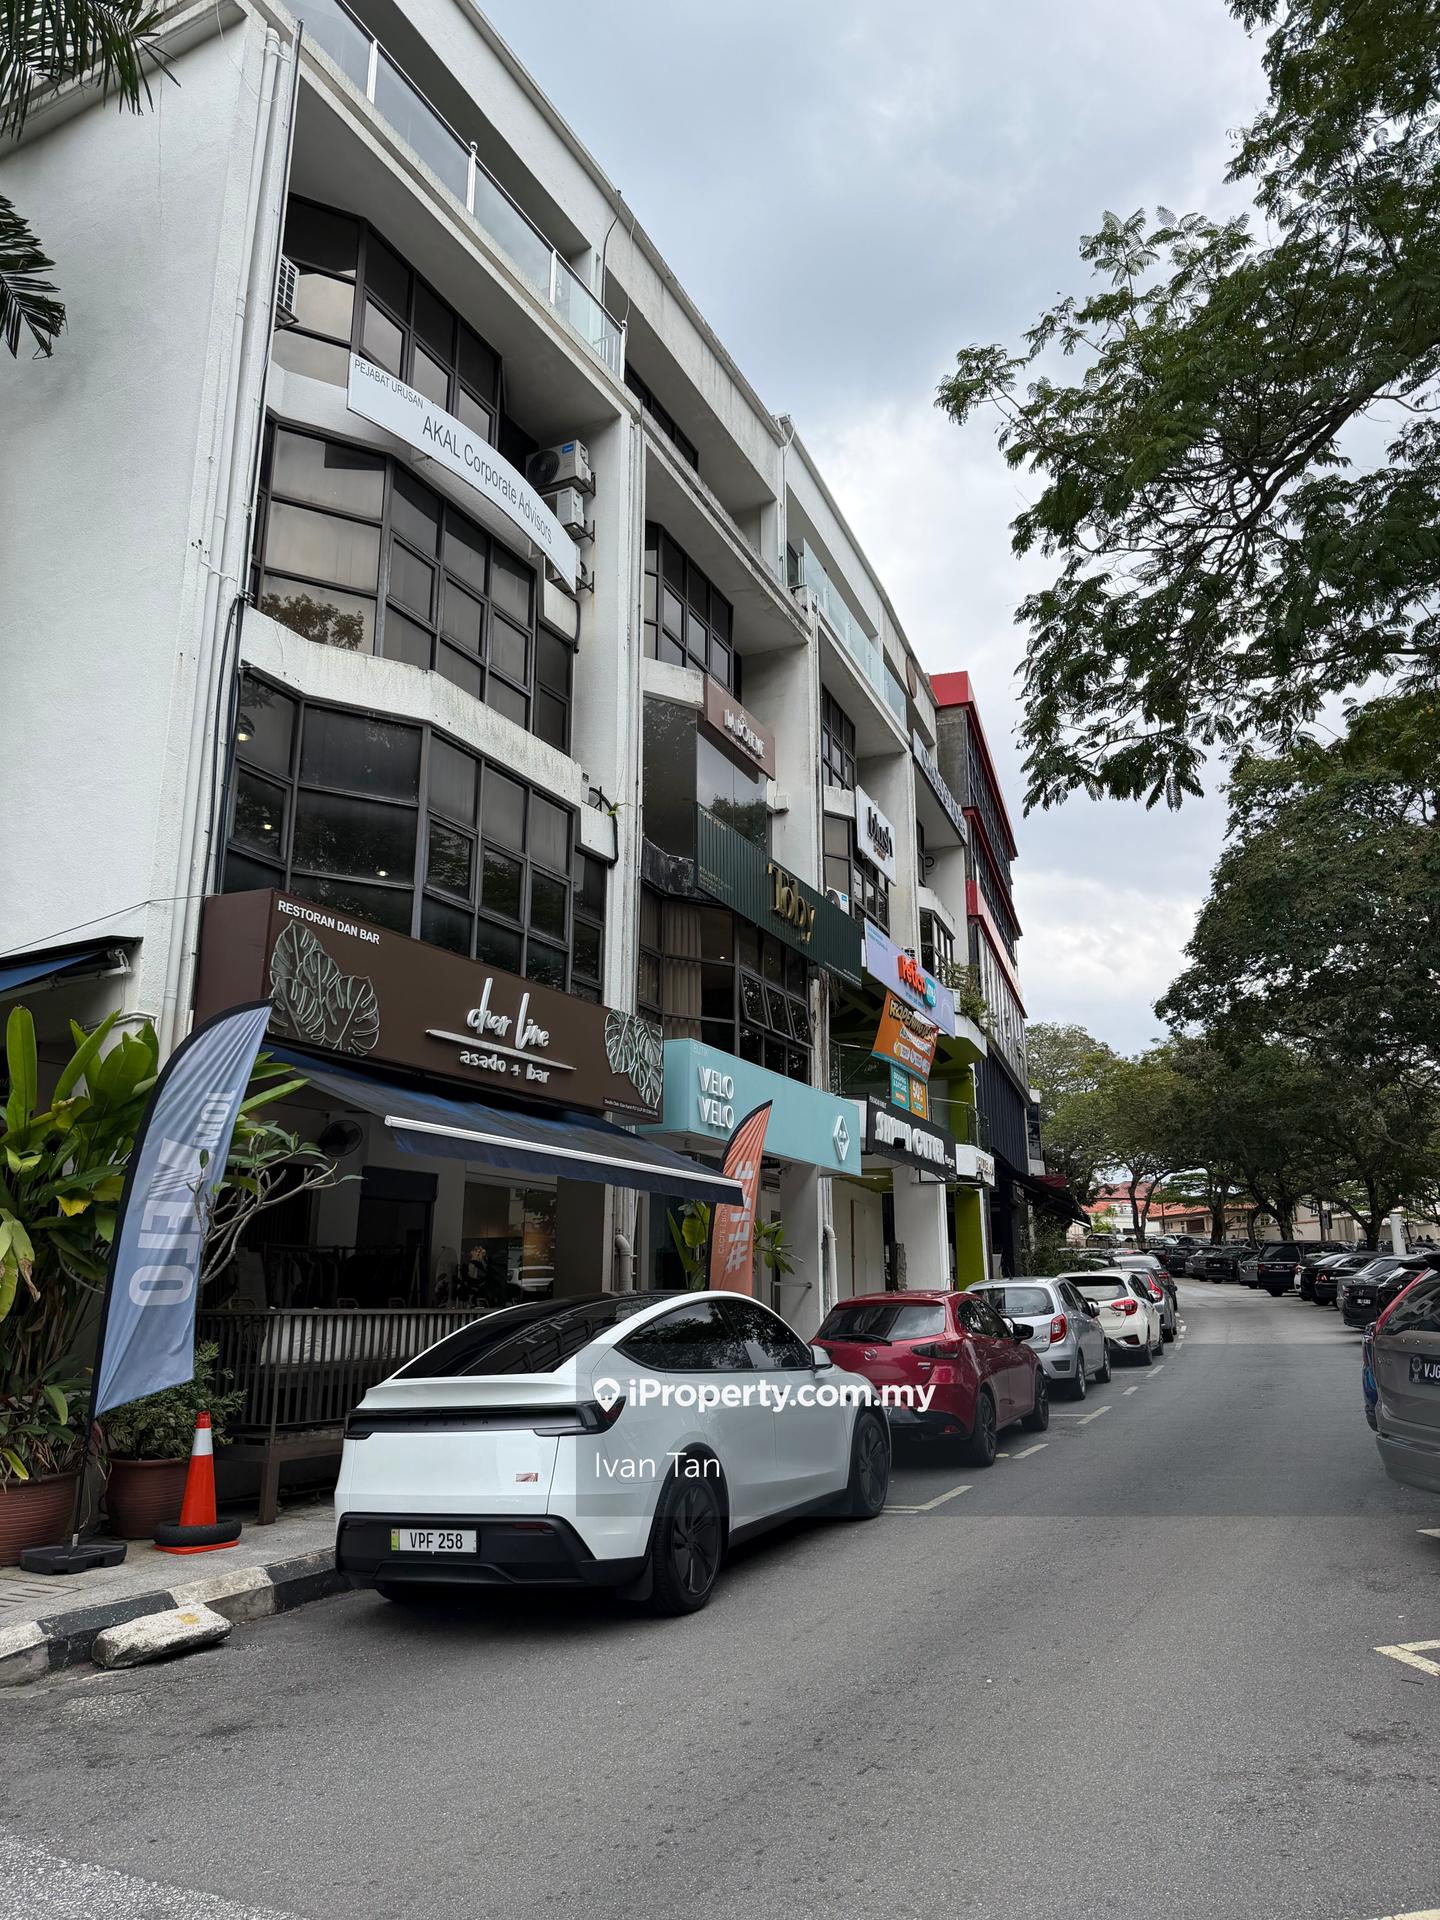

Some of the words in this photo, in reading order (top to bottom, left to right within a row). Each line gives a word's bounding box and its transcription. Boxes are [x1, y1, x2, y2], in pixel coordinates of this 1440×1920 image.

[354, 359, 390, 388] PEJABAT
[391, 379, 424, 409] URUSAN
[422, 415, 460, 458] AKAL
[464, 443, 517, 505] Corporate
[518, 491, 553, 545] Advisors
[867, 806, 893, 858] blush
[278, 900, 335, 929] RESTORAN
[337, 920, 358, 937] DAN
[360, 929, 380, 945] BAR
[515, 992, 550, 1049] line
[460, 1050, 506, 1073] asado
[526, 1063, 550, 1083] bar
[698, 1066, 734, 1100] VELO
[698, 1095, 735, 1129] VELO
[912, 1128, 945, 1164] CUTTER
[409, 1532, 434, 1549] VPF
[438, 1532, 463, 1549] 258
